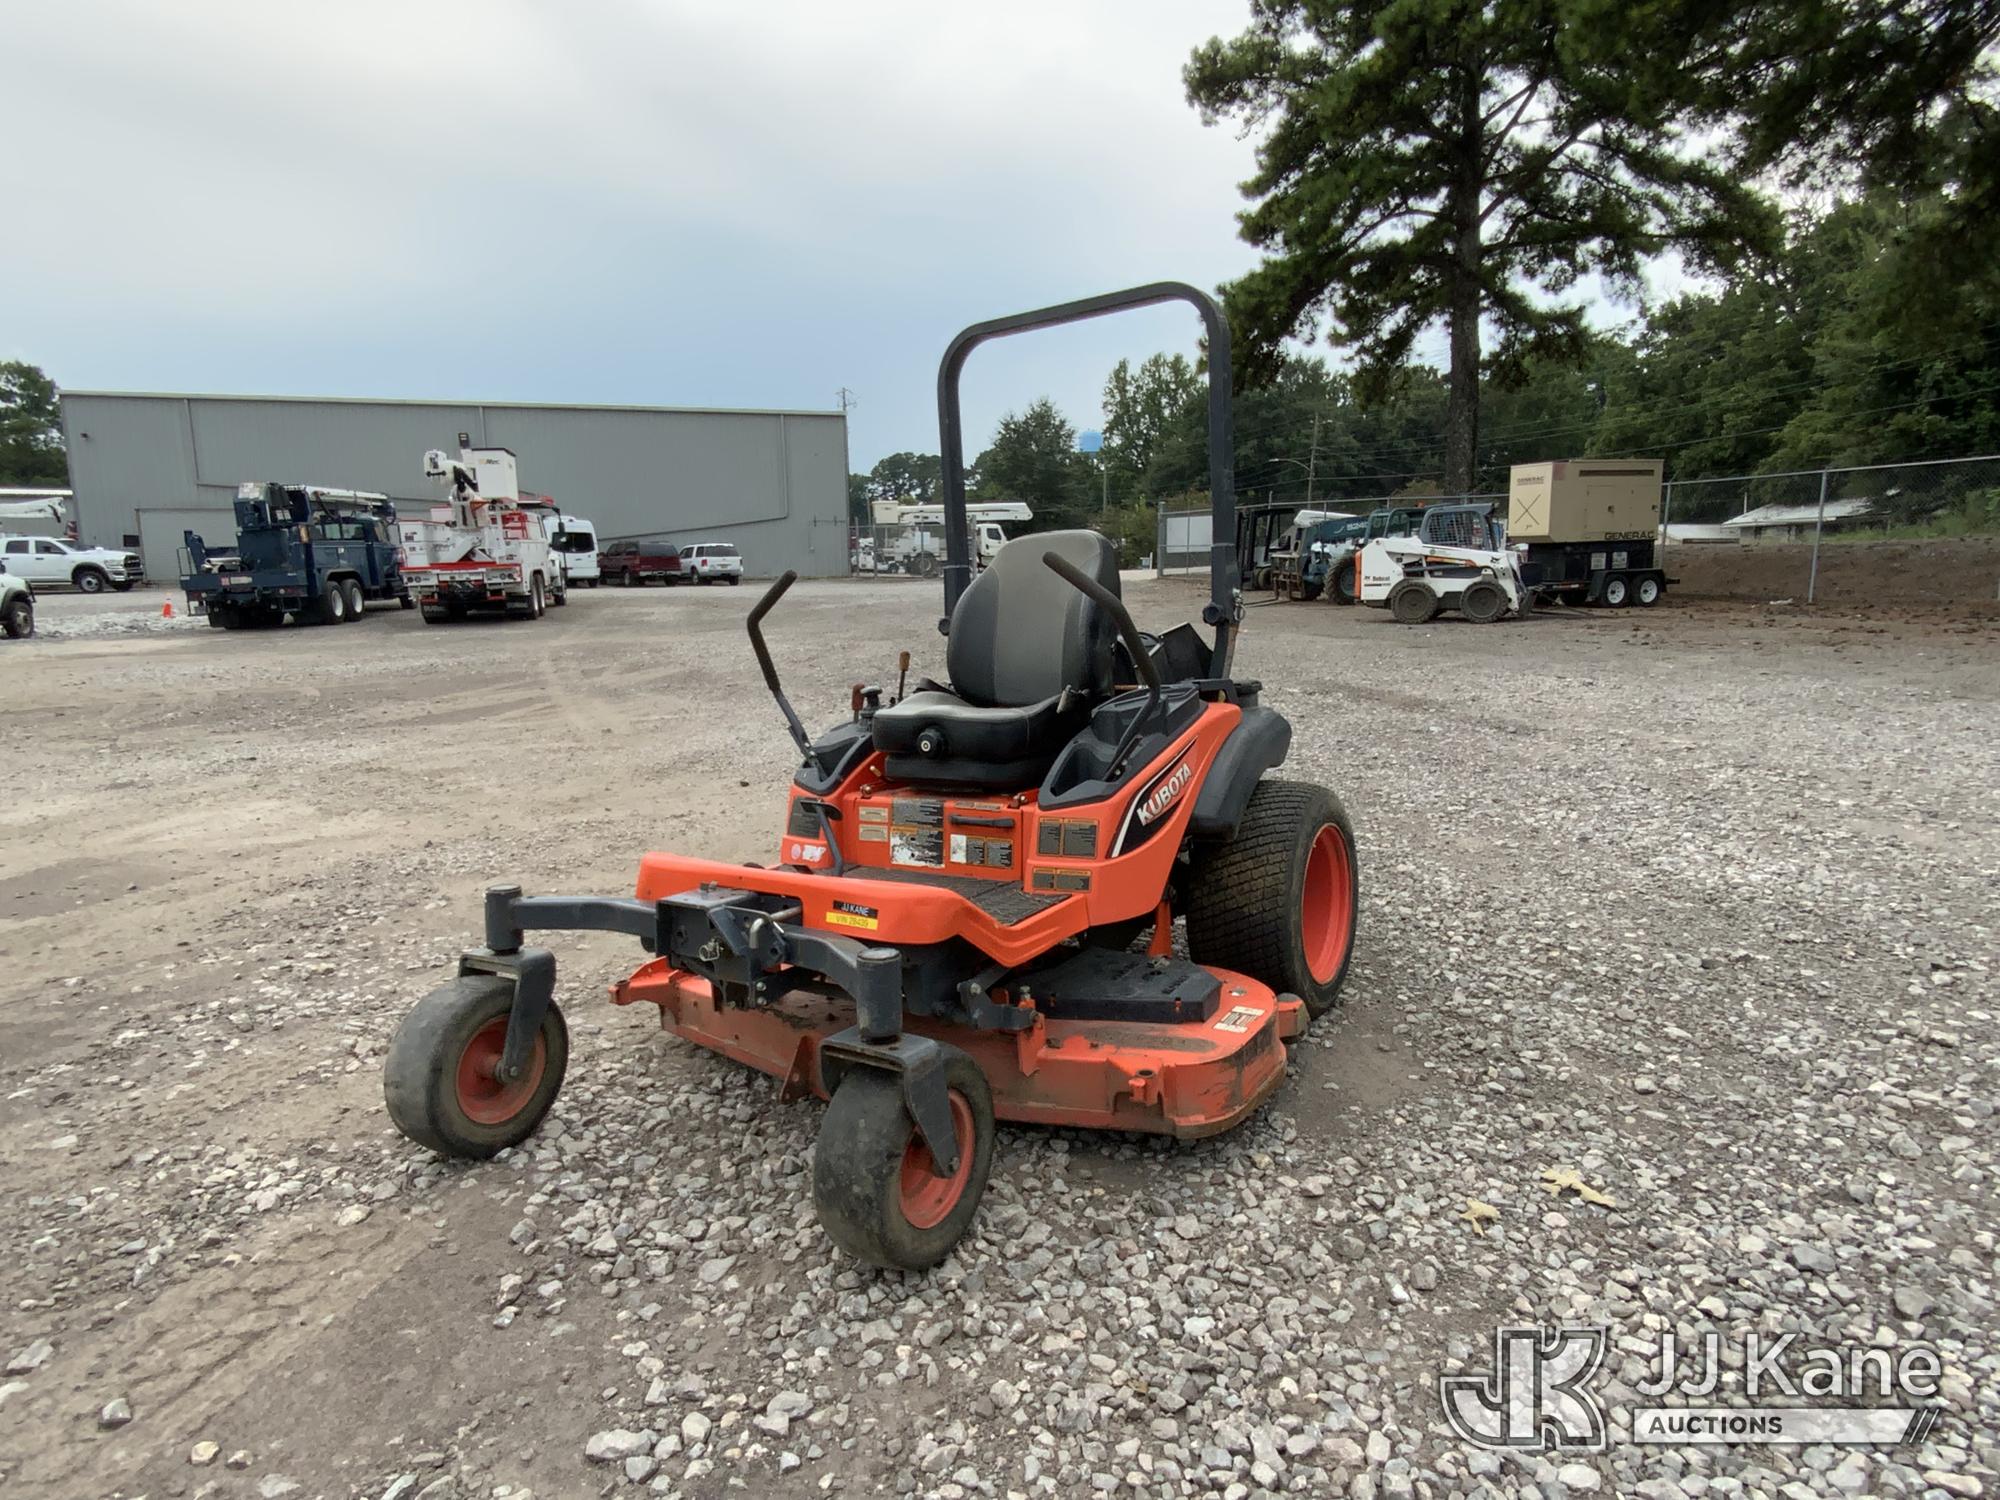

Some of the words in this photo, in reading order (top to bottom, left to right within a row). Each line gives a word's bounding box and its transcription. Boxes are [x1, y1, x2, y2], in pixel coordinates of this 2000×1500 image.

[1605, 531, 1654, 540] GENERAC
[1136, 763, 1192, 826] KUBOTA
[850, 904, 869, 916] KANE
